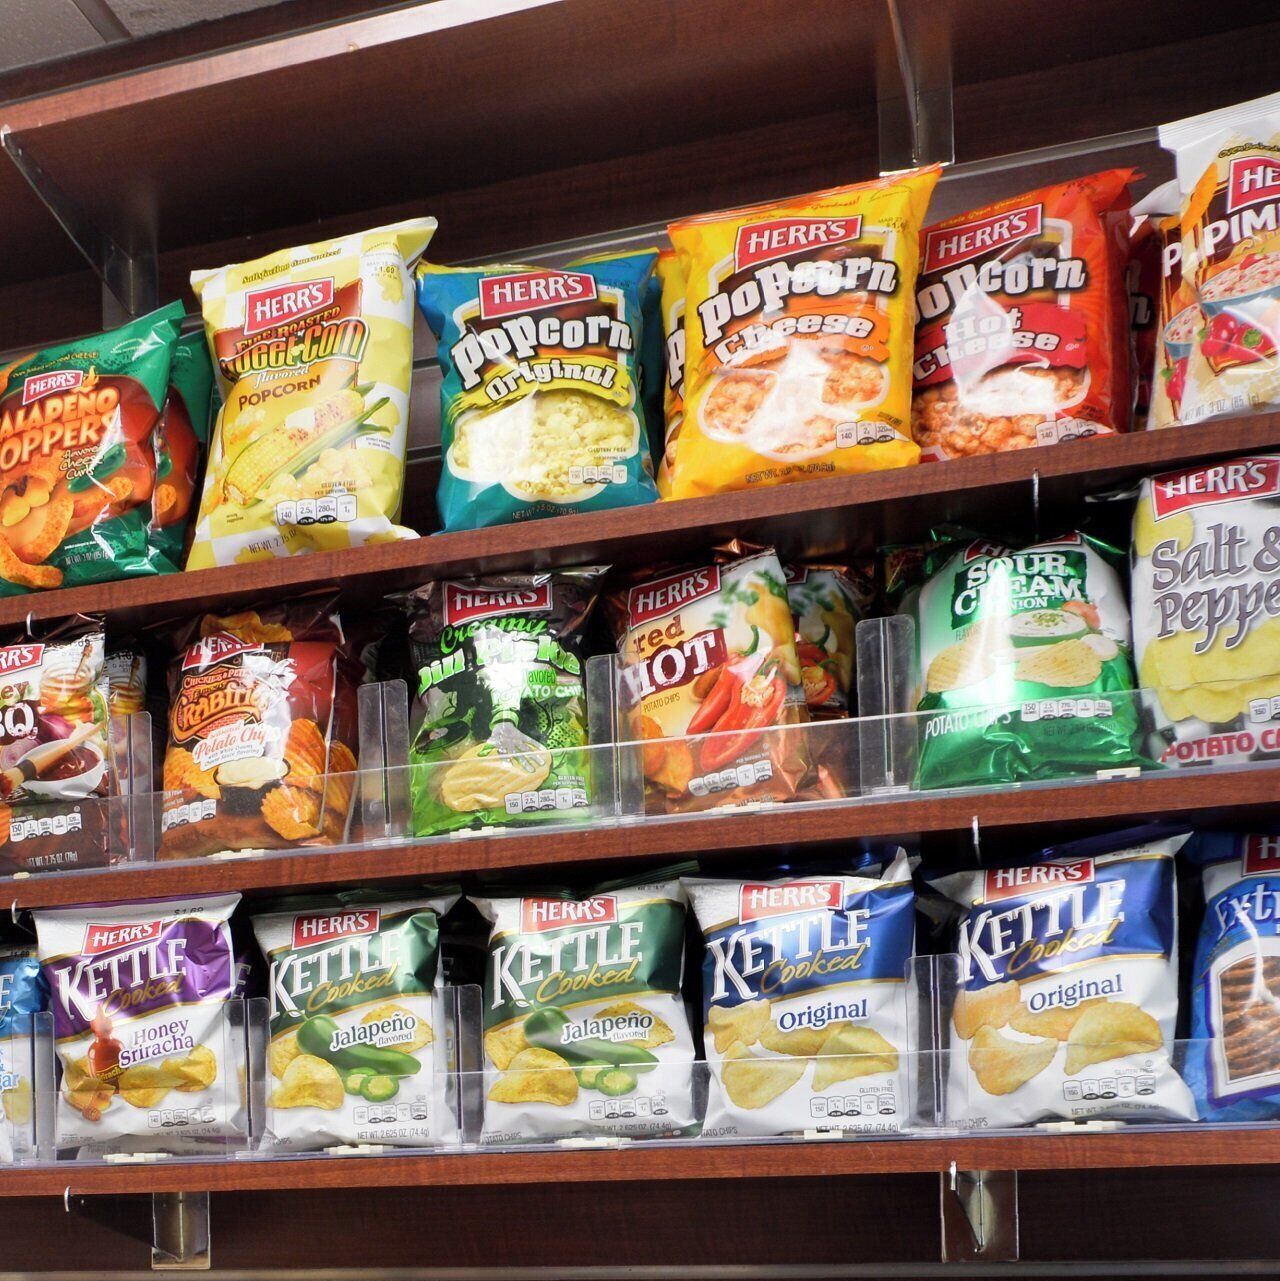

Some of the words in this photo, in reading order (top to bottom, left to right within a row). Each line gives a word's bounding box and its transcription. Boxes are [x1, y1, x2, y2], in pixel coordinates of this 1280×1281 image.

[747, 220, 847, 254] HERR'S
[939, 211, 1029, 259] HERR'S
[255, 282, 323, 321] HERR'S
[492, 276, 585, 304] HERR'S
[30, 373, 75, 395] HERR'S
[239, 375, 321, 411] POPCORN
[484, 359, 617, 402] Original
[1165, 461, 1268, 499] HERR'S
[967, 553, 1068, 589] SOUR
[1151, 522, 1246, 592] Salt
[635, 572, 710, 617] HERR'S
[1161, 732, 1255, 762] POTATO
[750, 884, 832, 907] HERR'S
[996, 864, 1083, 889] HERR'S
[302, 912, 370, 937] HERR'S
[531, 899, 605, 922] HERR'S
[92, 922, 157, 948] HERR'S
[957, 879, 1126, 983] KETTLE
[1007, 919, 1120, 975] Cooked
[270, 929, 402, 1019] KETTLE
[492, 921, 644, 1009] KETTLE
[707, 908, 871, 1002] KETTLE
[761, 945, 867, 994] Cooked
[54, 938, 188, 1021] KETTLE
[103, 974, 185, 1018] Cooked
[307, 964, 398, 1012] Cooked
[536, 959, 639, 1001] Cooked
[1029, 974, 1123, 1012] Original
[134, 1020, 189, 1046] Honey
[332, 1012, 417, 1049] Jalapeño
[562, 1012, 653, 1044] Jalapeño
[778, 999, 868, 1032] Original
[119, 1035, 195, 1067] Sriracha
